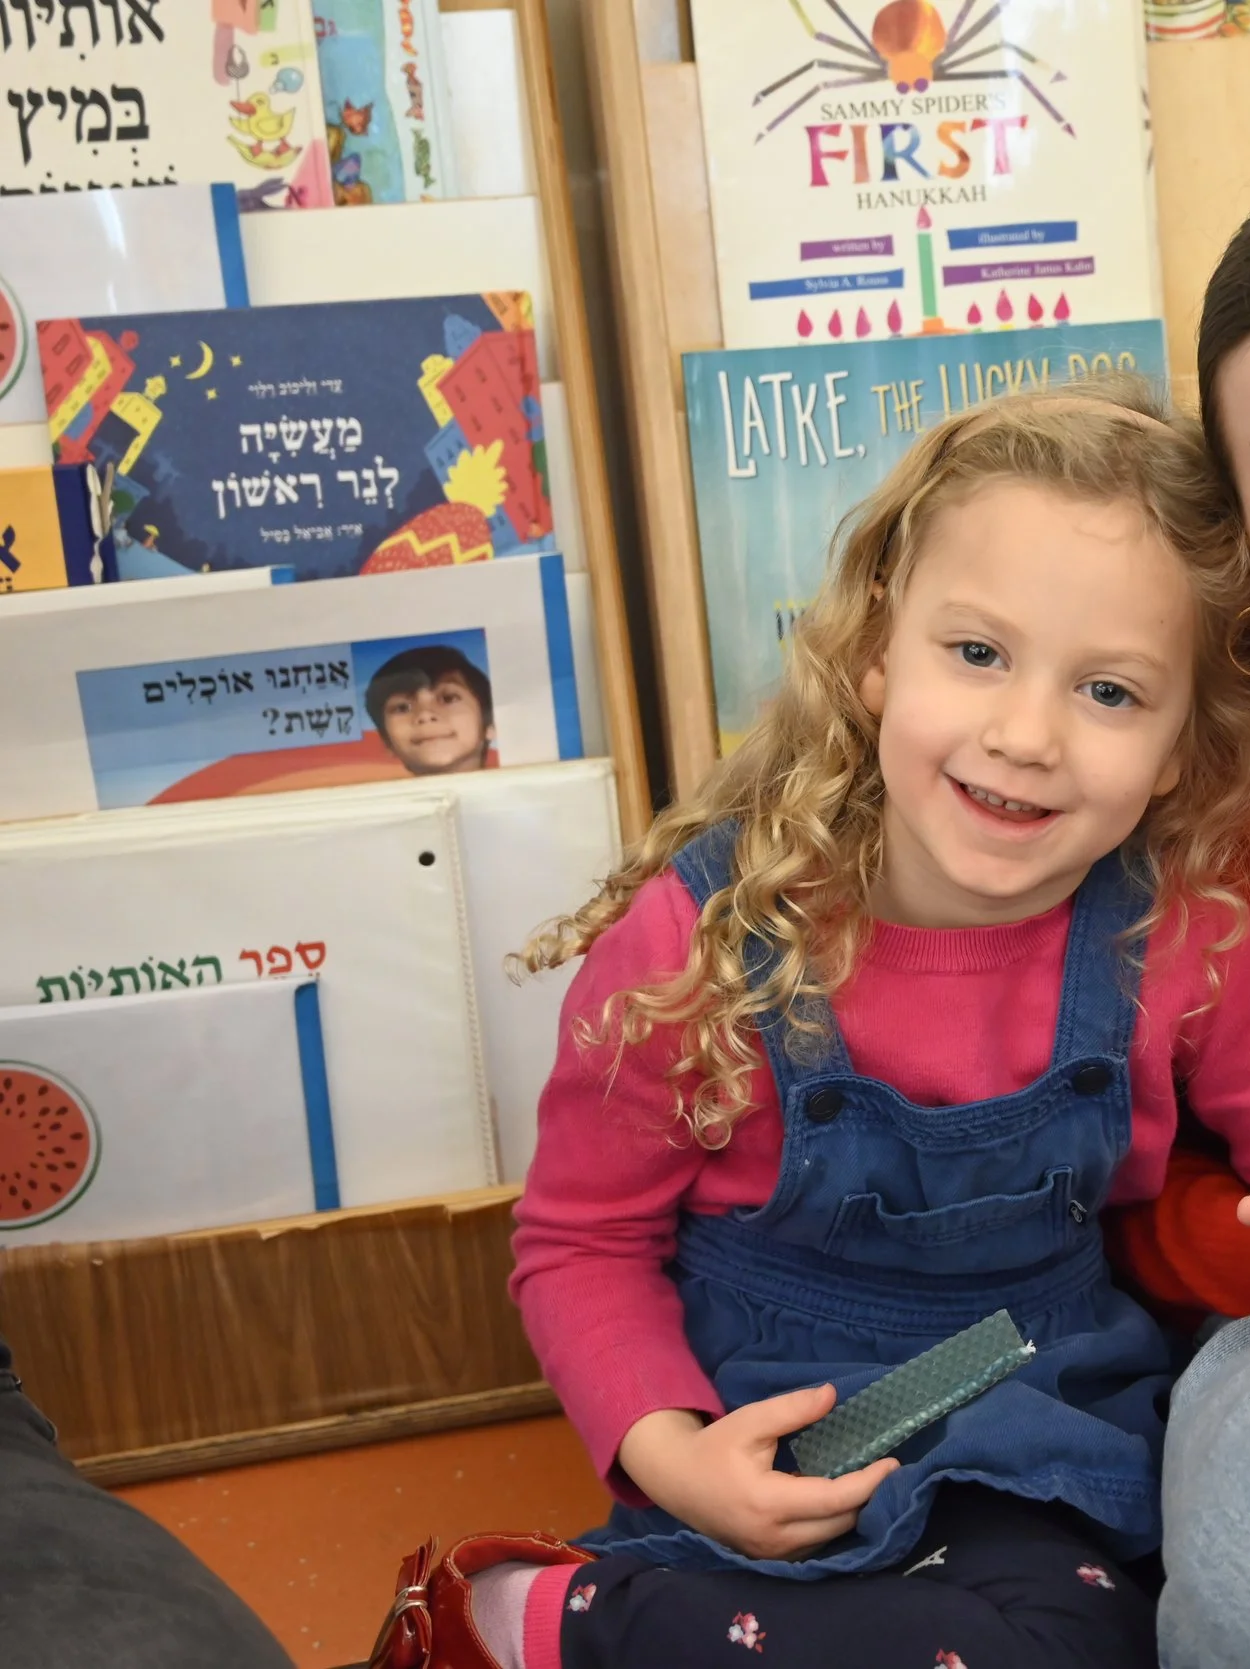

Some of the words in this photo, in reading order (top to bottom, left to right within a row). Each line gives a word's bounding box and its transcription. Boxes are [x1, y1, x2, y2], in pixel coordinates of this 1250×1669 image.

[820, 99, 903, 121] SAMMY
[911, 93, 1007, 115] SPIDER'S
[804, 114, 1029, 187] FIRST
[857, 184, 987, 210] HANUKKAH
[718, 370, 866, 478] LATKE,
[871, 380, 924, 436] THE
